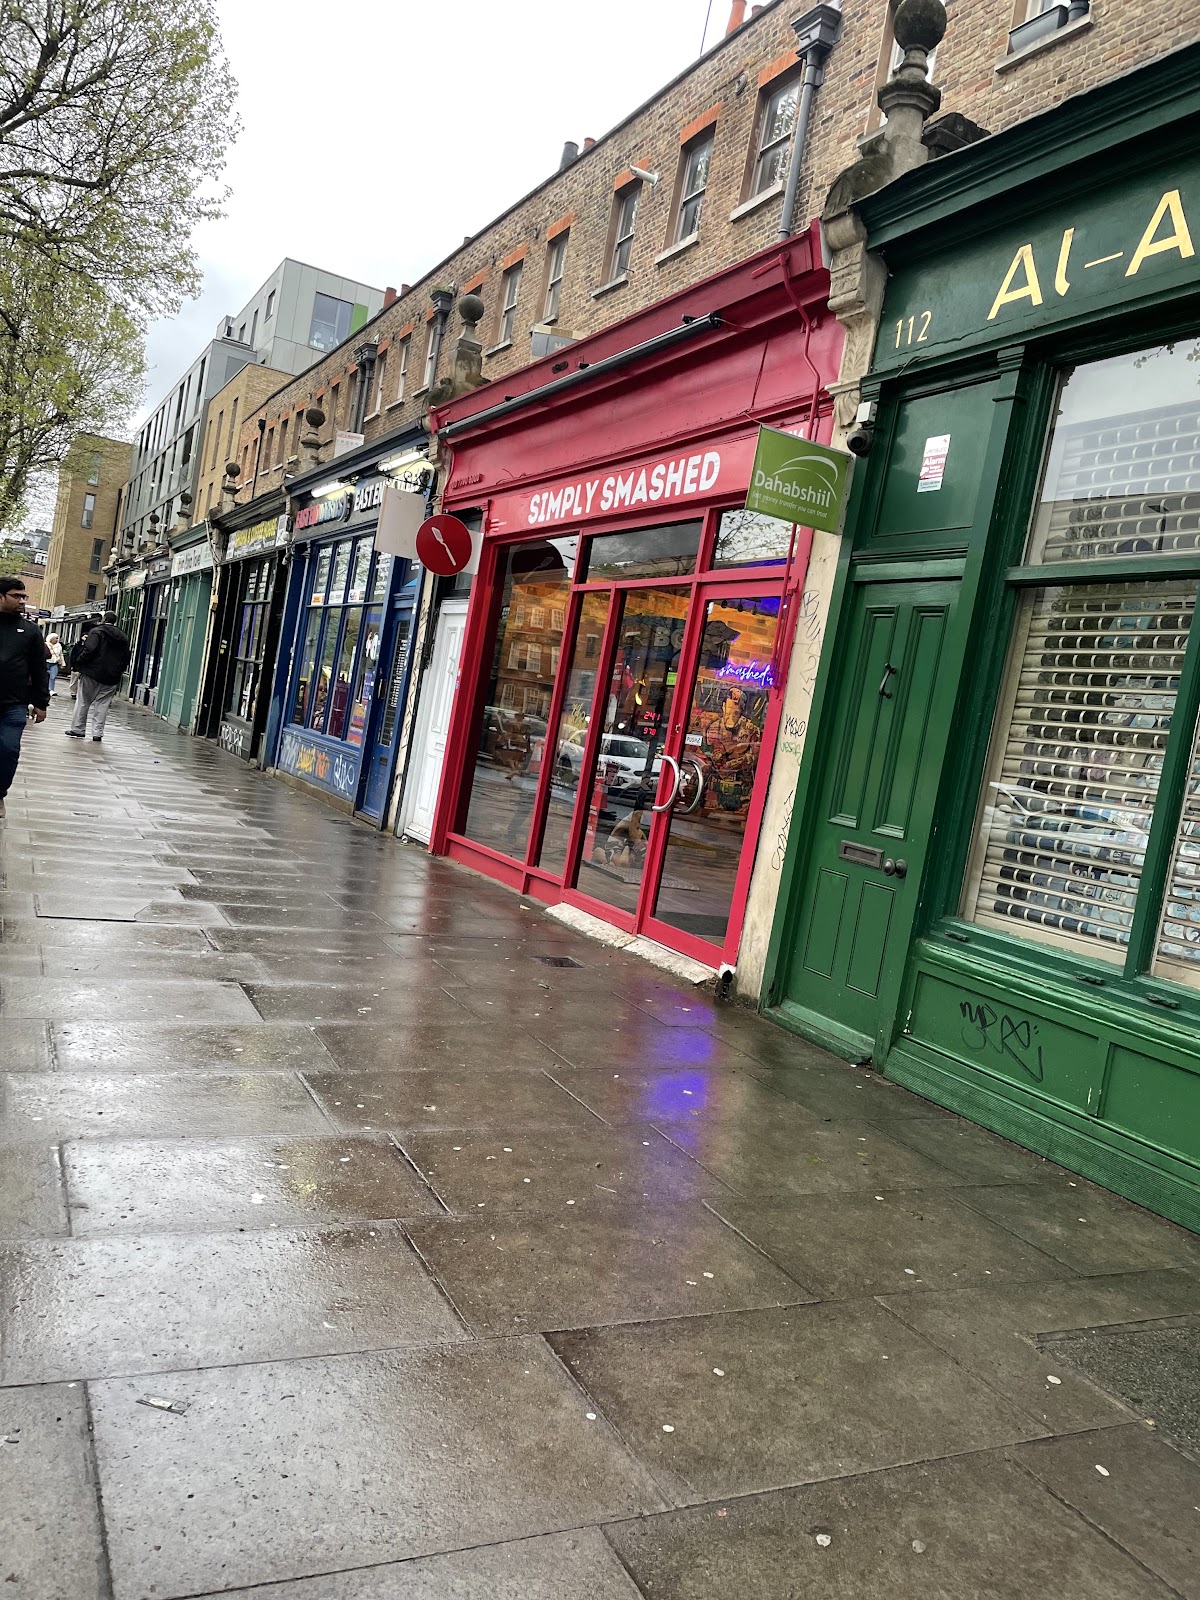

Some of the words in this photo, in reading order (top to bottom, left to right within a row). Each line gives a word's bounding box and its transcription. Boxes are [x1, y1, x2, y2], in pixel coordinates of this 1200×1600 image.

[895, 311, 932, 348] 112
[923, 456, 944, 466] Alarm
[528, 480, 600, 524] SIMPLY
[600, 451, 721, 511] SMASHED
[754, 470, 831, 507] Dahabshiil
[780, 498, 798, 509] transfer
